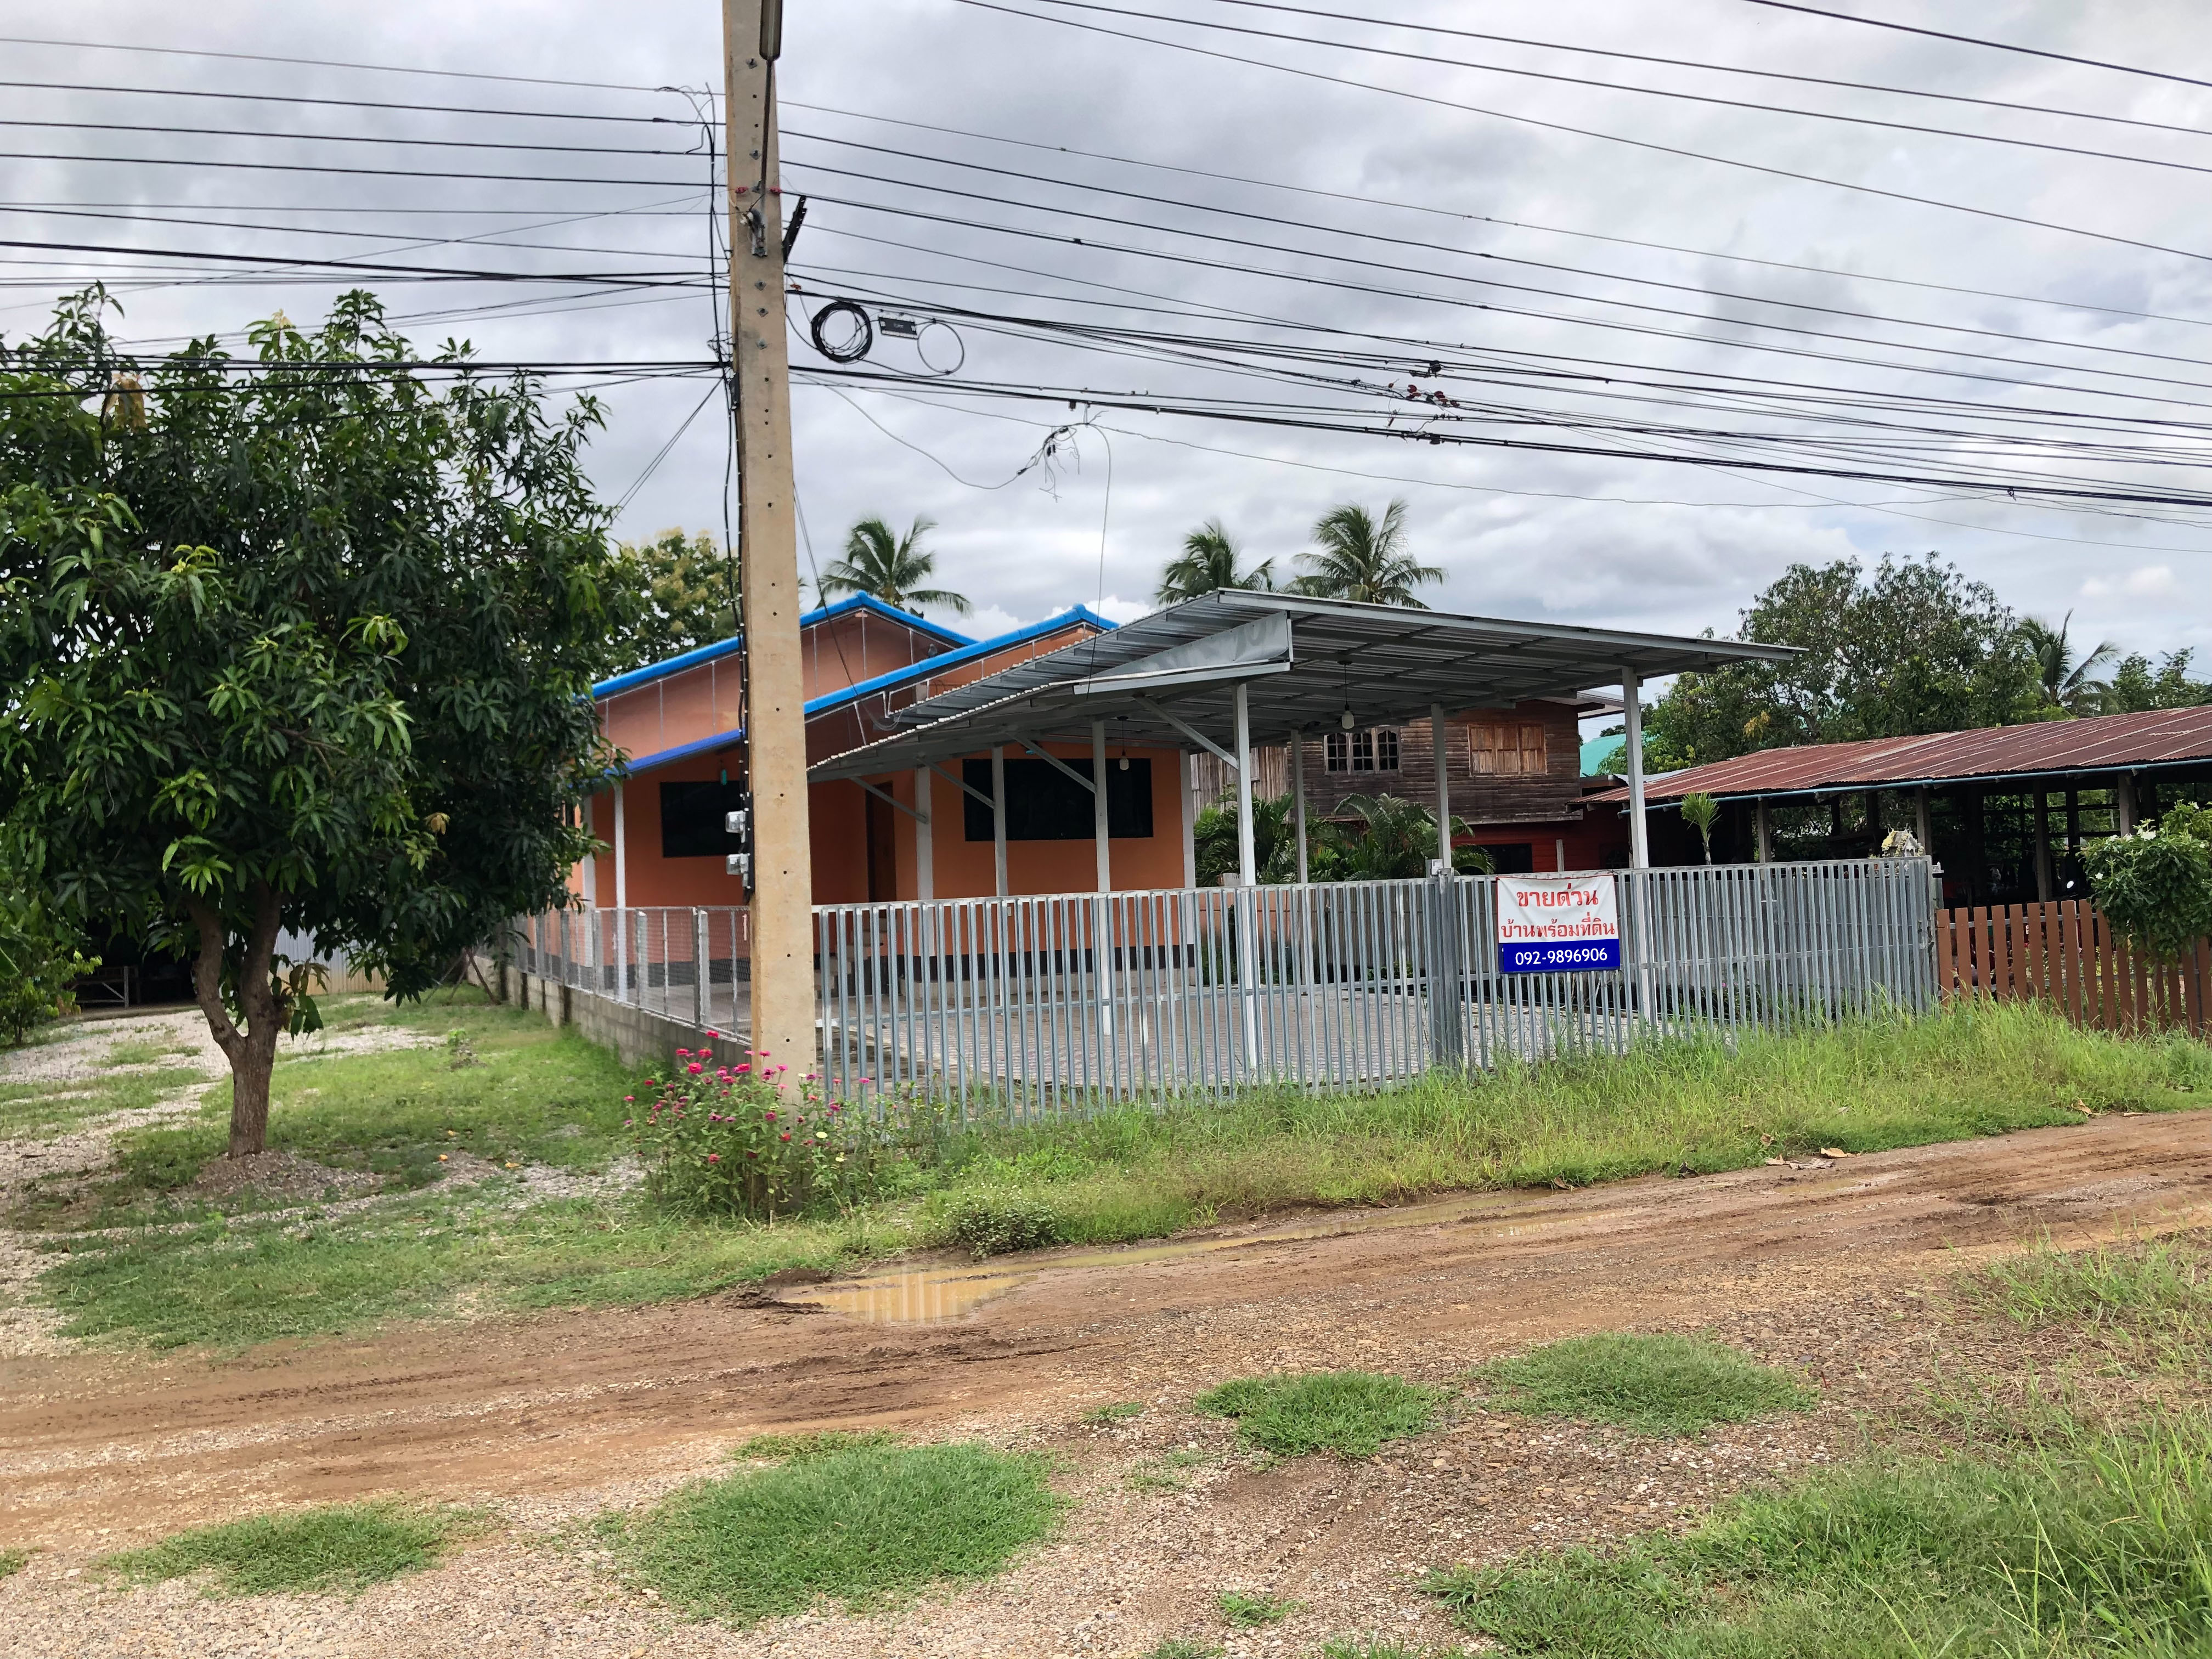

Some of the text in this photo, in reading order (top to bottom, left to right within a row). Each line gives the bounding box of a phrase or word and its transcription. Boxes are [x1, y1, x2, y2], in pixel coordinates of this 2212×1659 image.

[1516, 883, 1598, 907] ขายด่วน
[1501, 912, 1615, 938] บ้านพร้อมที่ดิน
